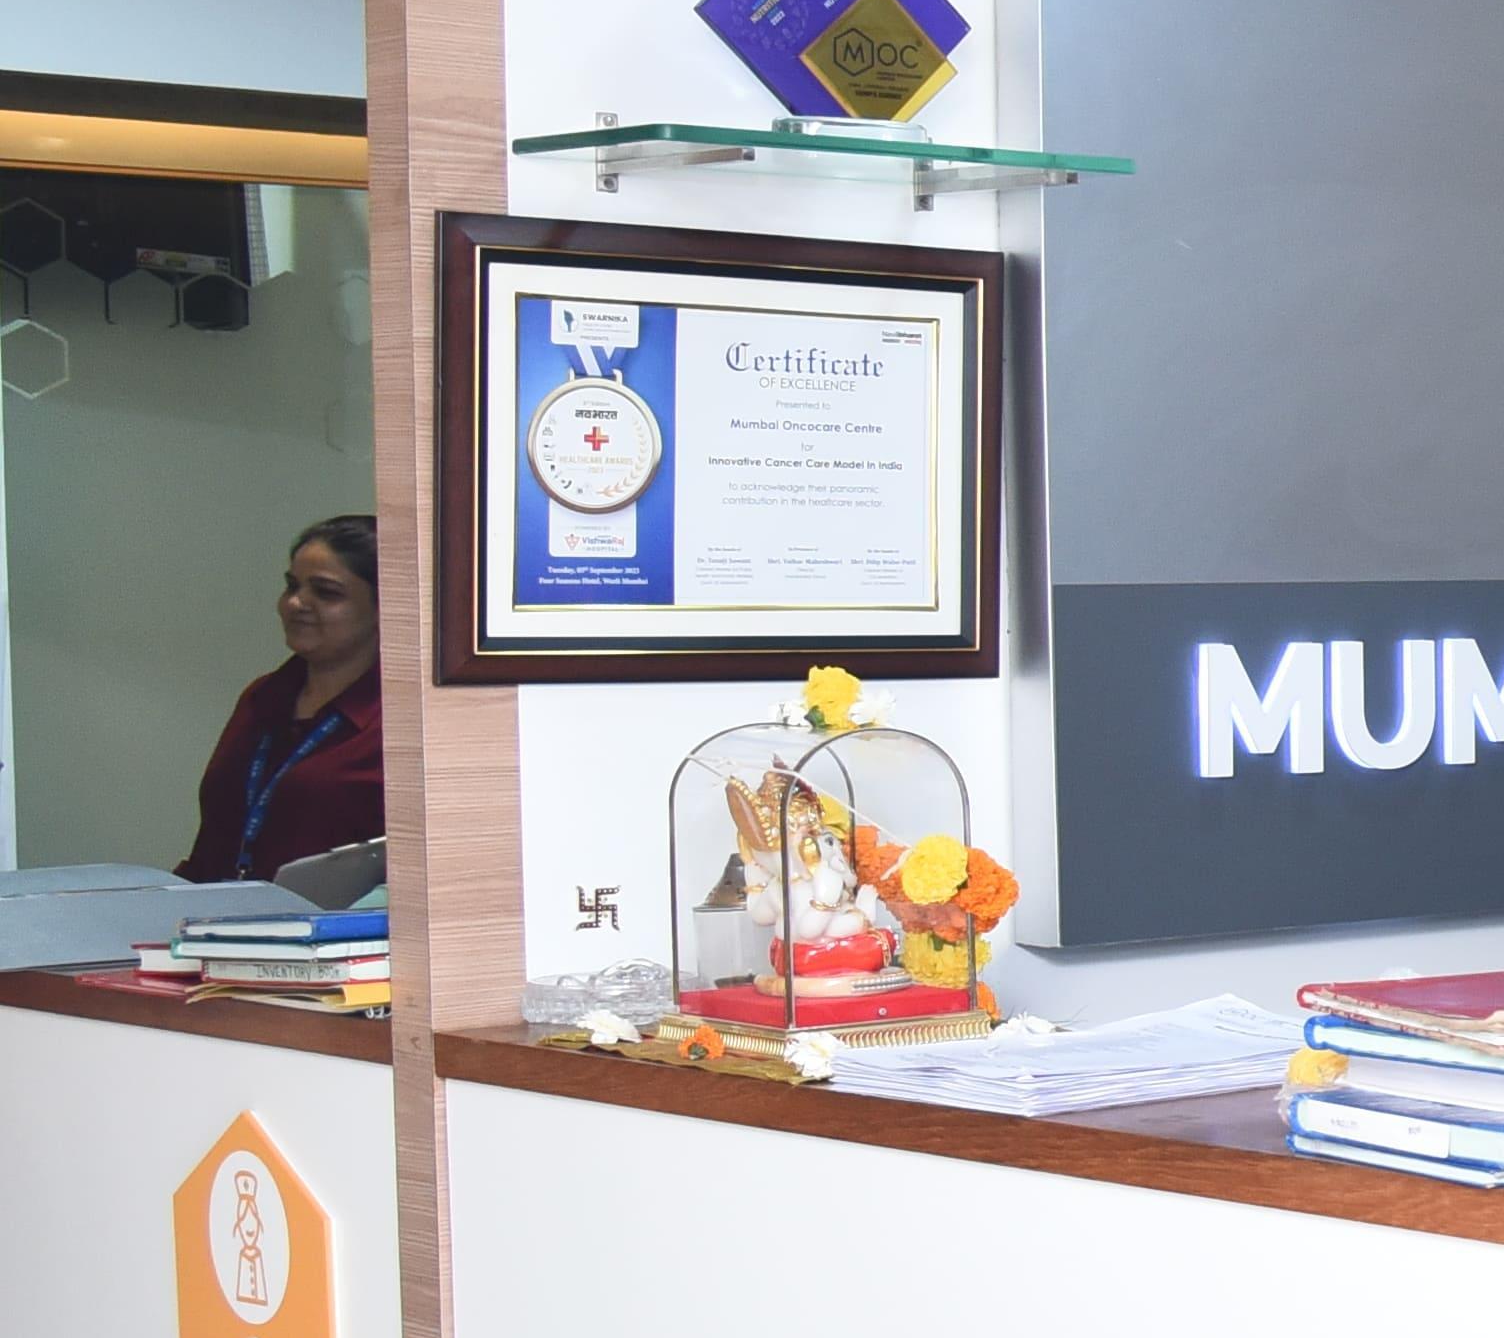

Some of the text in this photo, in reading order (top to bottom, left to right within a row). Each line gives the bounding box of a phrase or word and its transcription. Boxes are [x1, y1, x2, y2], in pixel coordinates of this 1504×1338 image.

[726, 342, 884, 377] Certificate
[759, 377, 856, 392] OF EXCELLENCE
[776, 400, 831, 410] Presented to
[783, 421, 841, 432] Oncocare
[845, 423, 883, 434] Centre
[801, 443, 814, 452] for
[708, 457, 762, 467] Innovative
[765, 458, 803, 468] Cancer
[806, 459, 830, 469] Care
[833, 460, 864, 470] Model
[878, 461, 903, 471] India
[256, 964, 312, 981] INVENTORY
